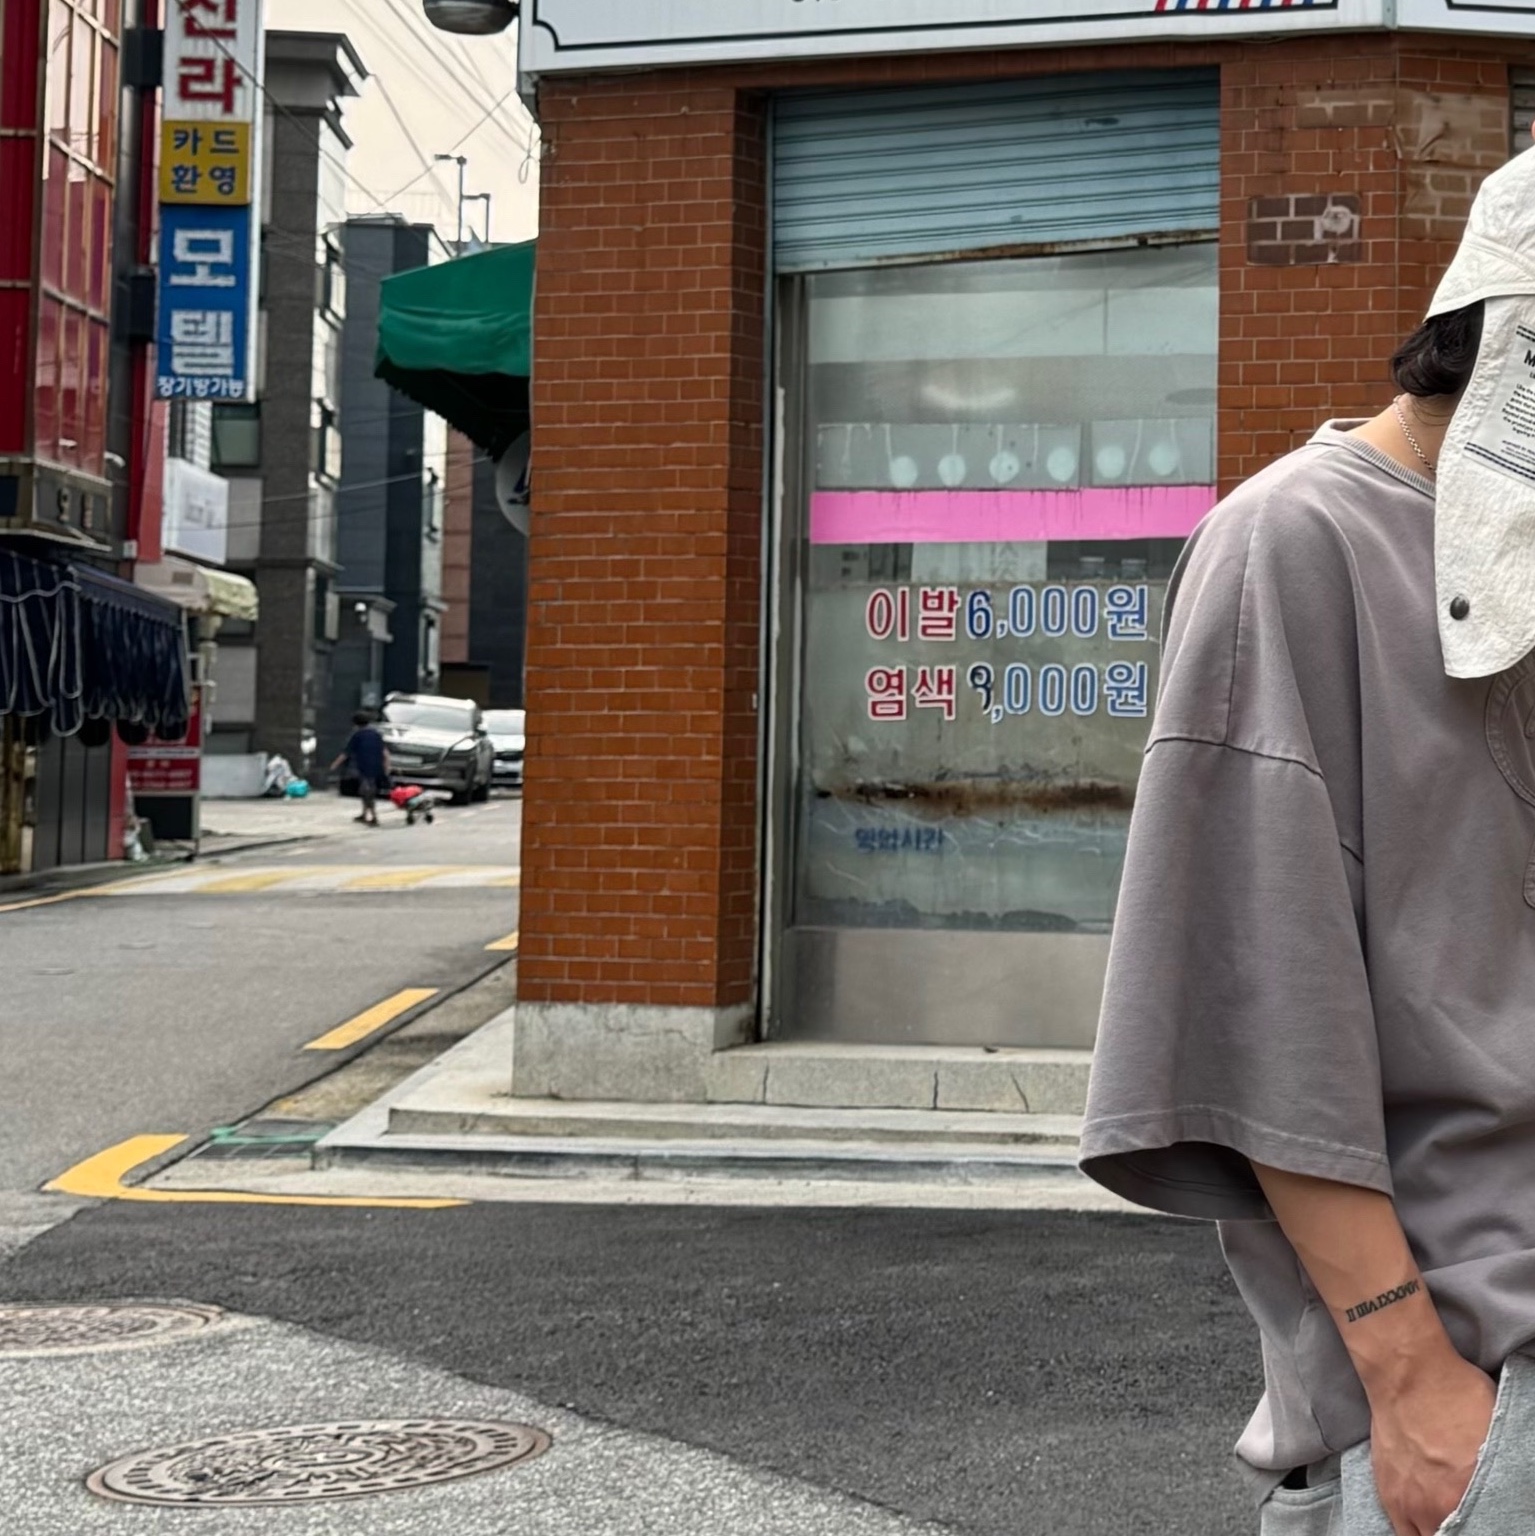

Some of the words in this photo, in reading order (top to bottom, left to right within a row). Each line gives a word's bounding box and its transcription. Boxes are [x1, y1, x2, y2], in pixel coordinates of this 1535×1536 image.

[174, 128, 240, 156] 카드
[171, 165, 236, 195] 환영
[169, 229, 236, 376] 모텔
[866, 585, 960, 642] 이발
[966, 585, 1148, 642] 6,000원
[865, 665, 957, 721] 염색
